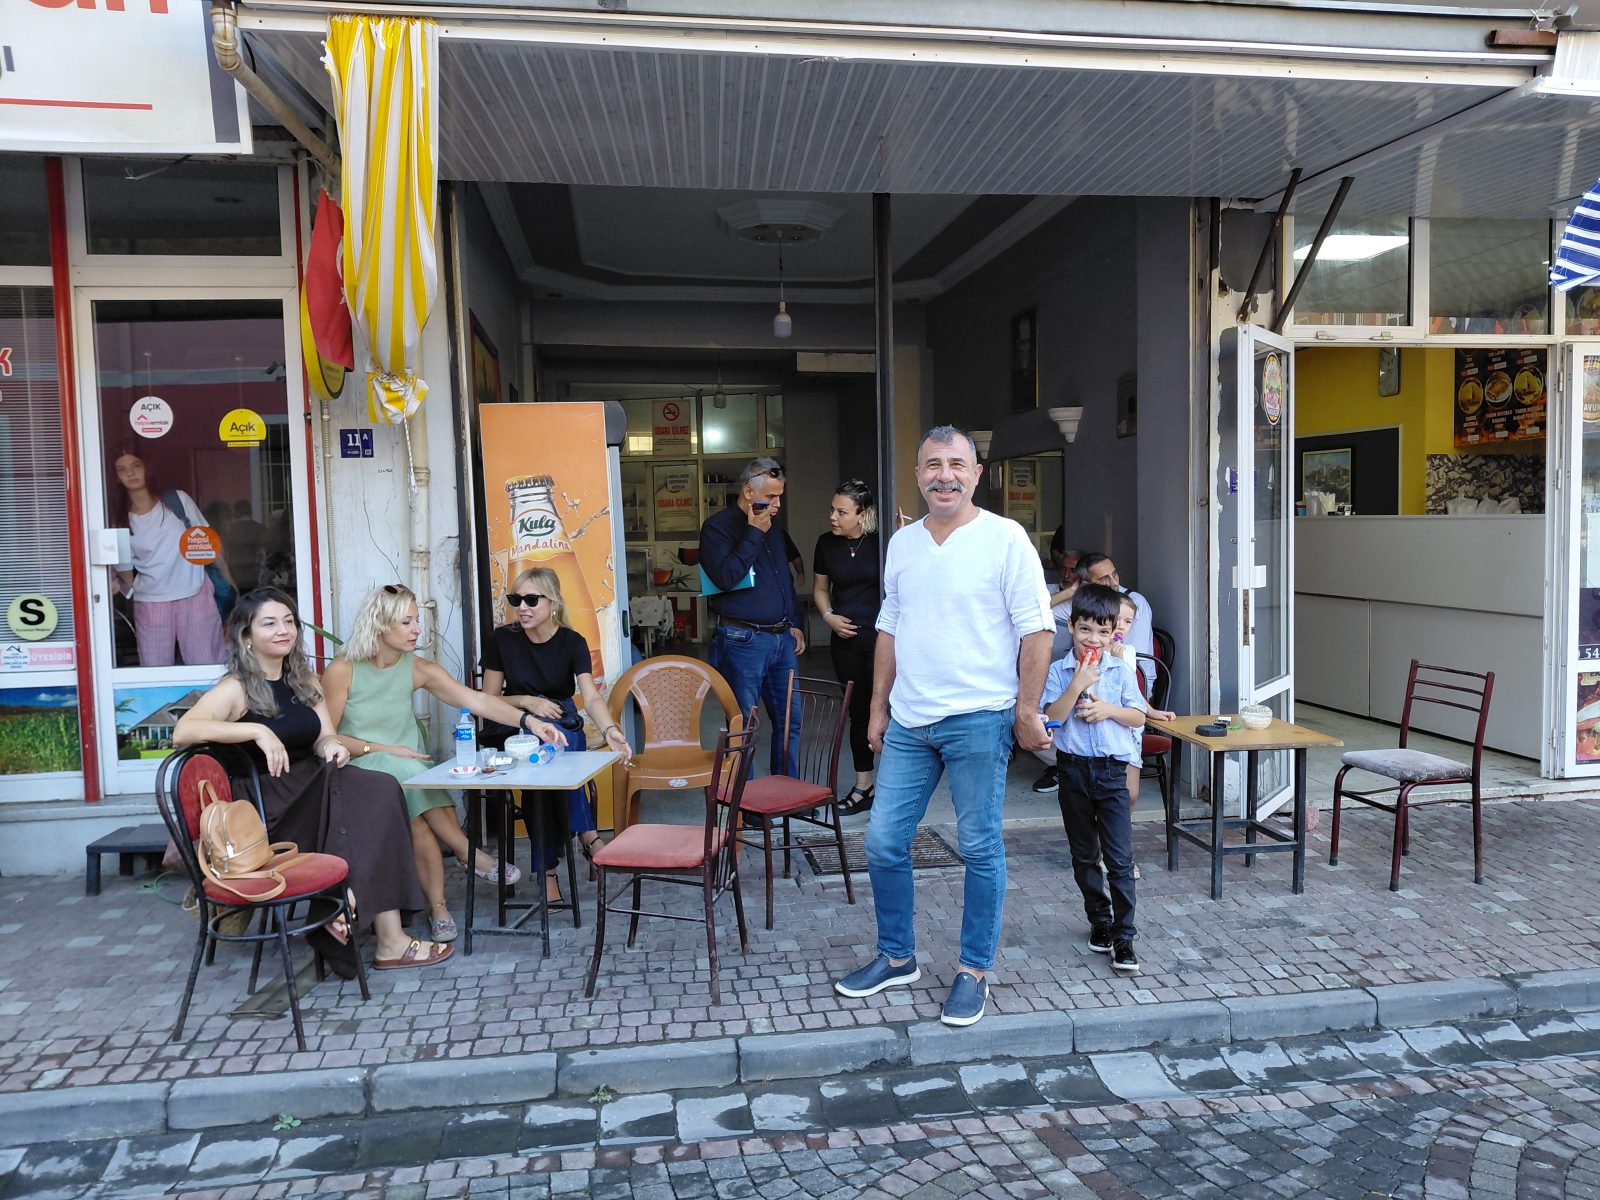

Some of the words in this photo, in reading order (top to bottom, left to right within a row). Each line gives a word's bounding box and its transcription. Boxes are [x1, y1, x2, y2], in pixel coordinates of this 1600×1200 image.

[140, 403, 161, 412] AÇIK
[229, 421, 256, 434] Açık
[346, 433, 361, 447] 11
[518, 514, 556, 533] Kula
[511, 538, 570, 557] Mandalina
[19, 599, 45, 625] S
